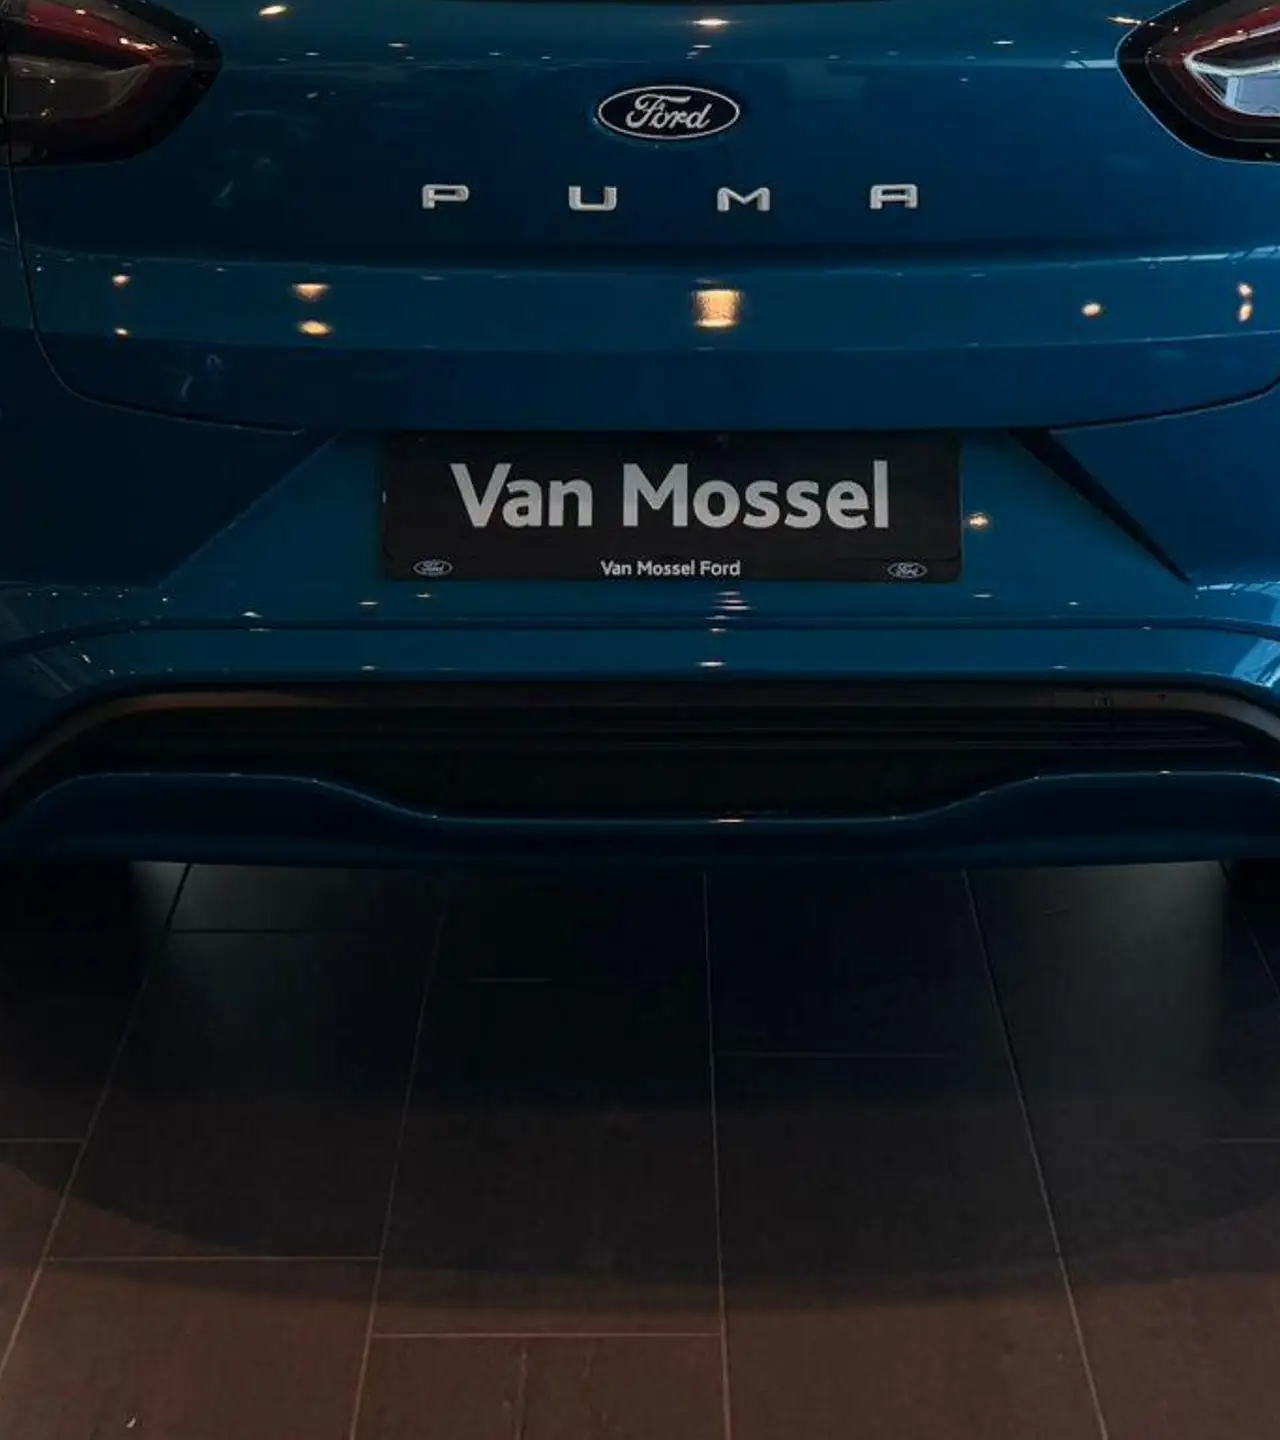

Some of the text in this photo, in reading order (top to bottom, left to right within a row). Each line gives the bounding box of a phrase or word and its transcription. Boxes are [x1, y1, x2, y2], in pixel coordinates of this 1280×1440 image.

[625, 93, 710, 130] Ford
[422, 183, 919, 212] PUMA
[449, 460, 890, 530] Van Mossel
[600, 559, 742, 577] Van Mossel Ford
